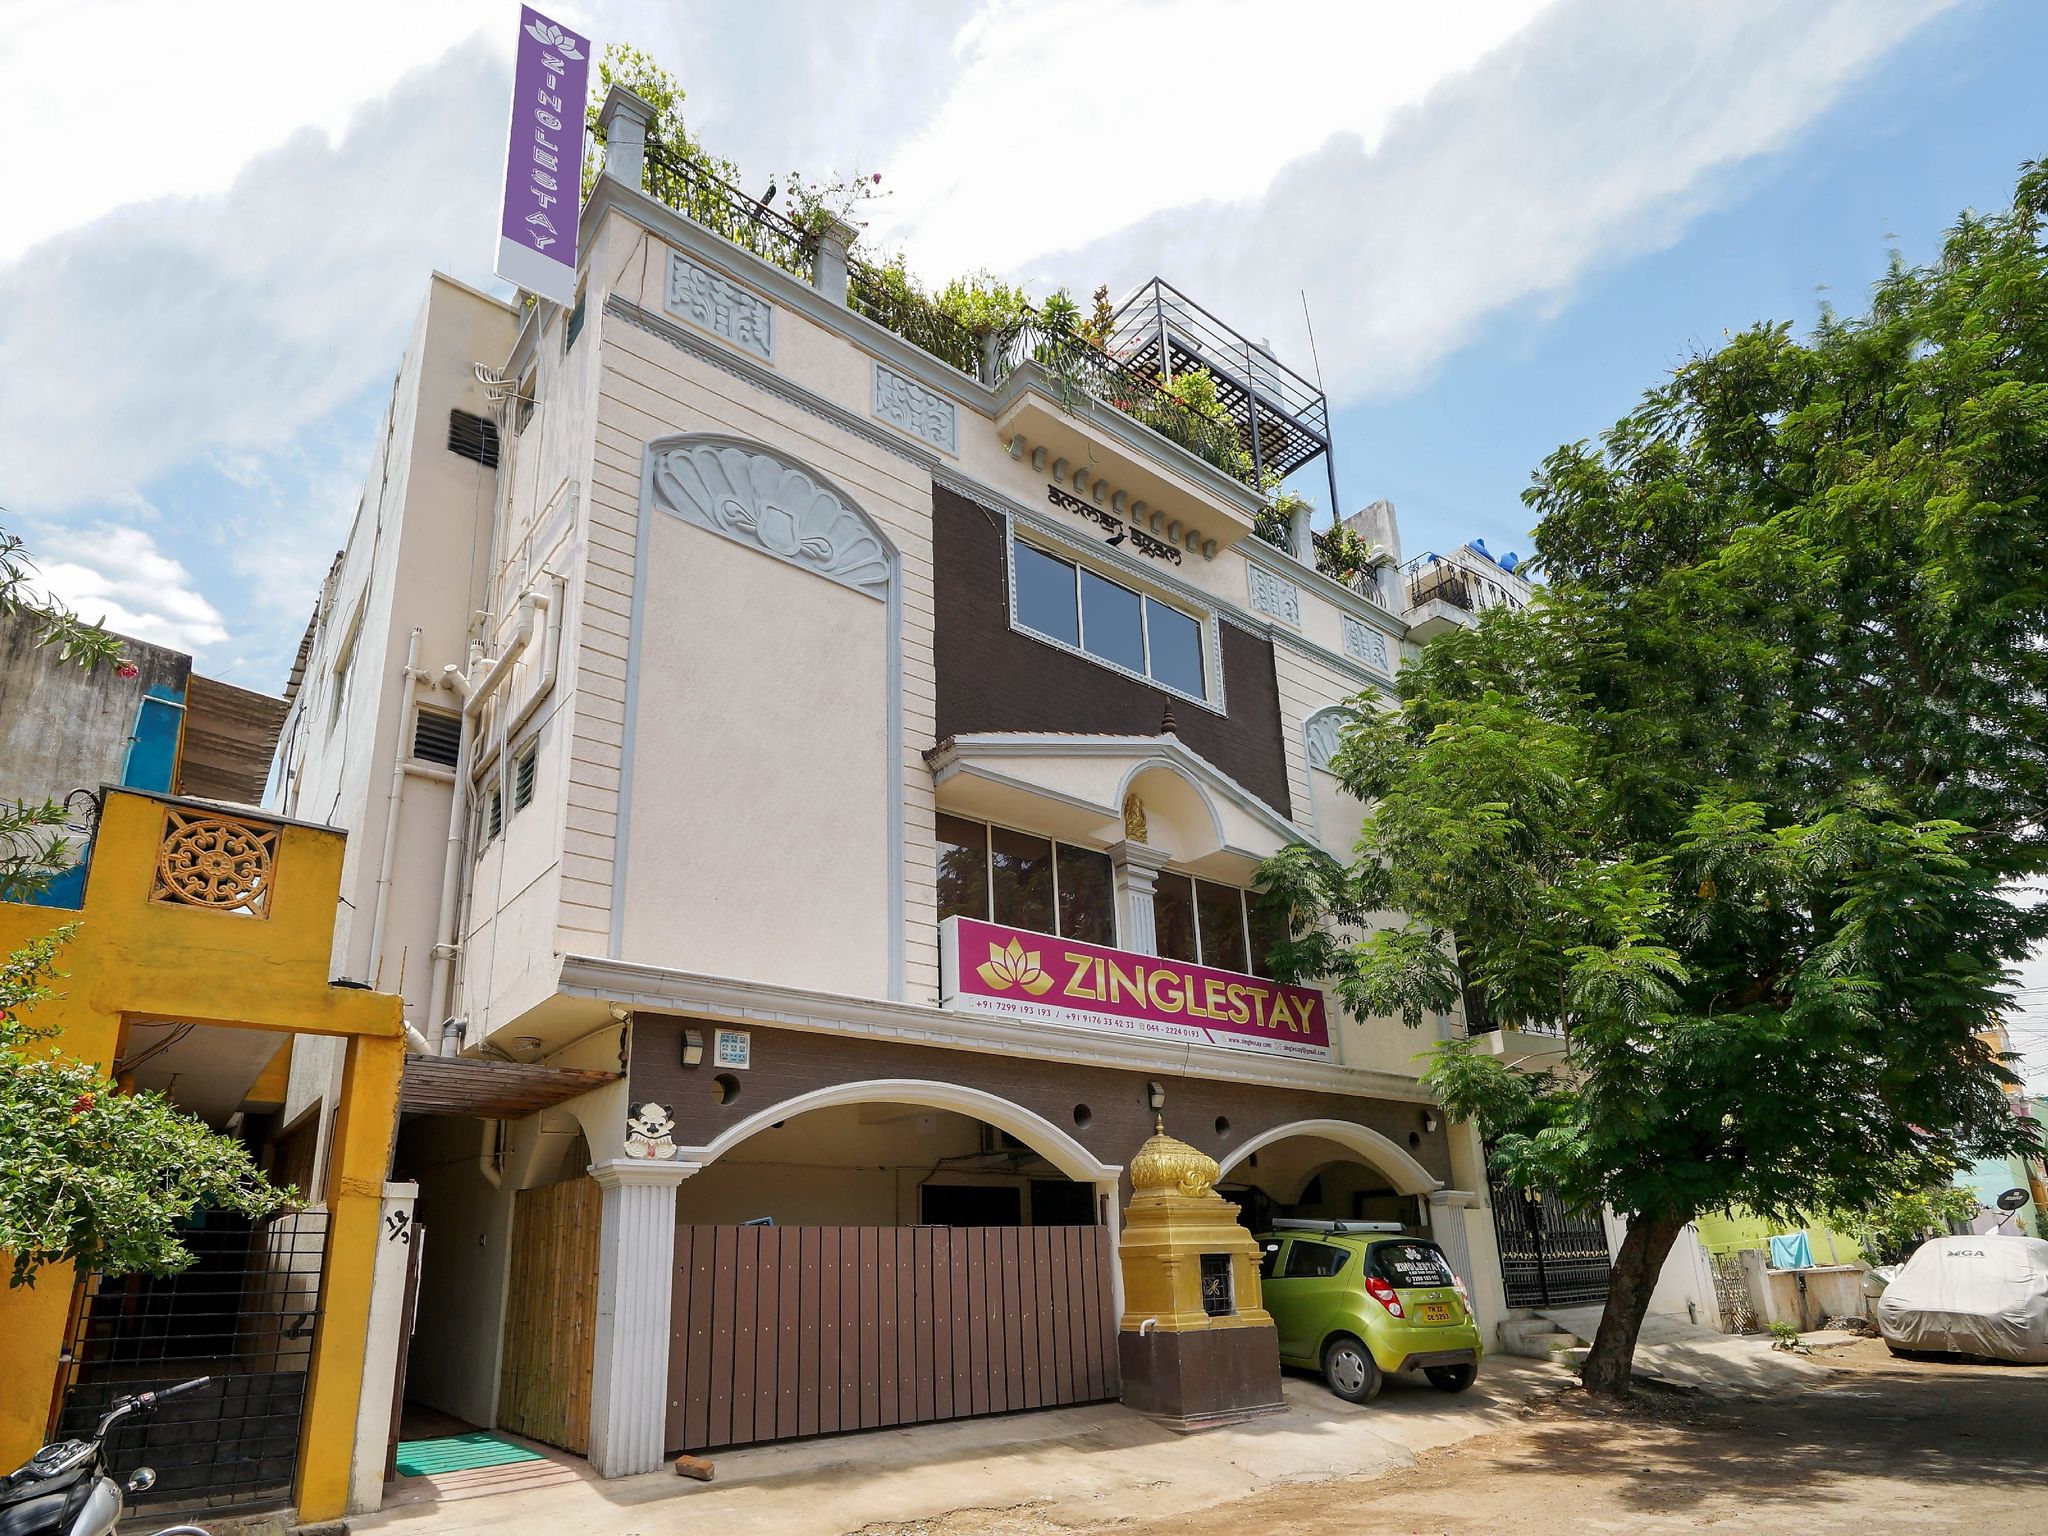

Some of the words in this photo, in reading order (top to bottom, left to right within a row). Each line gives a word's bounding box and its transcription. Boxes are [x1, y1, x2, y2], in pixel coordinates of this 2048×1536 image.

[525, 50, 565, 250] ZINGLESTAY
[976, 1000, 992, 1009] +91
[996, 1002, 1016, 1012] 7299
[1020, 1006, 1034, 1014] 193
[1037, 1008, 1051, 1016] 193
[1066, 1013, 1080, 1021] +91
[1083, 1015, 1101, 1024] 9176
[1146, 1024, 1160, 1032] 044
[1166, 1027, 1182, 1035] 2224
[1183, 1029, 1199, 1038] 0193
[1063, 951, 1316, 1034] ZINGLESTAY
